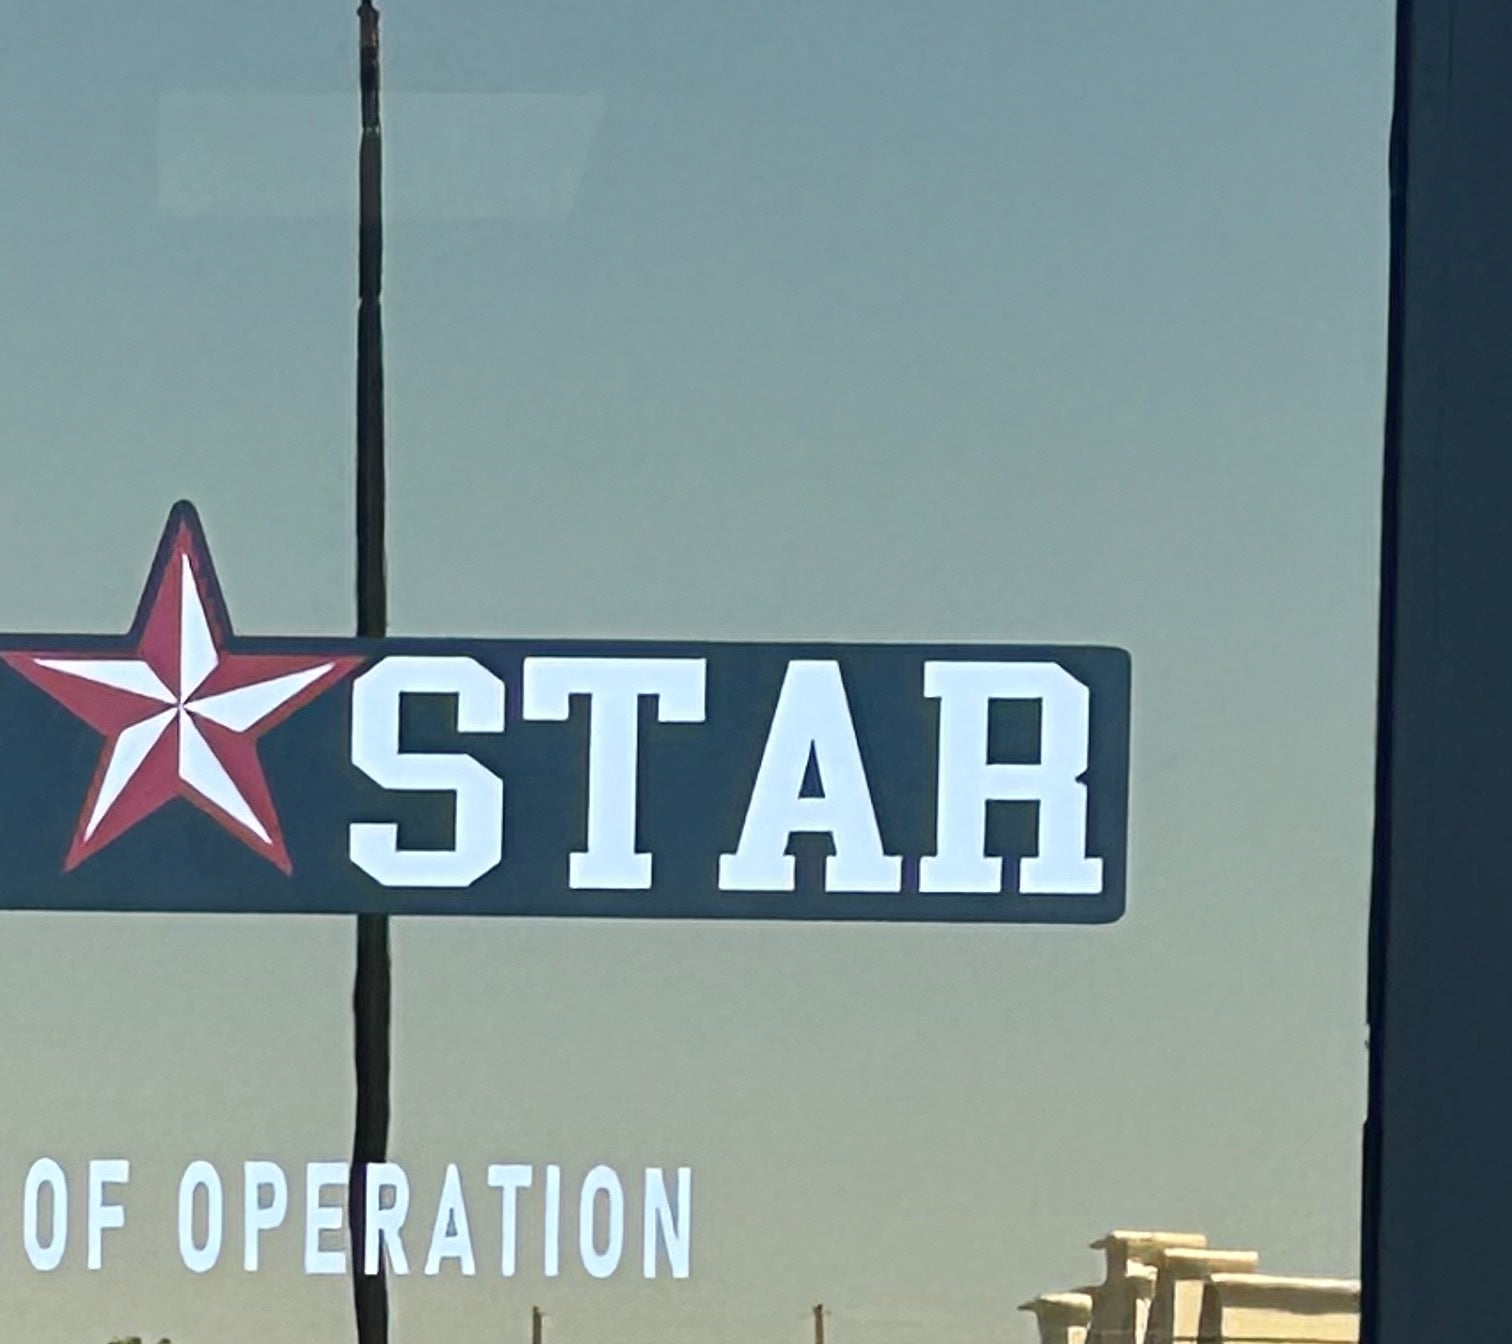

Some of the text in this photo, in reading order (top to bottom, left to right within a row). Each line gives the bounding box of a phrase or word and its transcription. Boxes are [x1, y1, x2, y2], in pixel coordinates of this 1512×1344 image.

[349, 655, 1104, 895] STAR
[22, 1158, 130, 1272] OF
[177, 1160, 693, 1280] OPERATION
